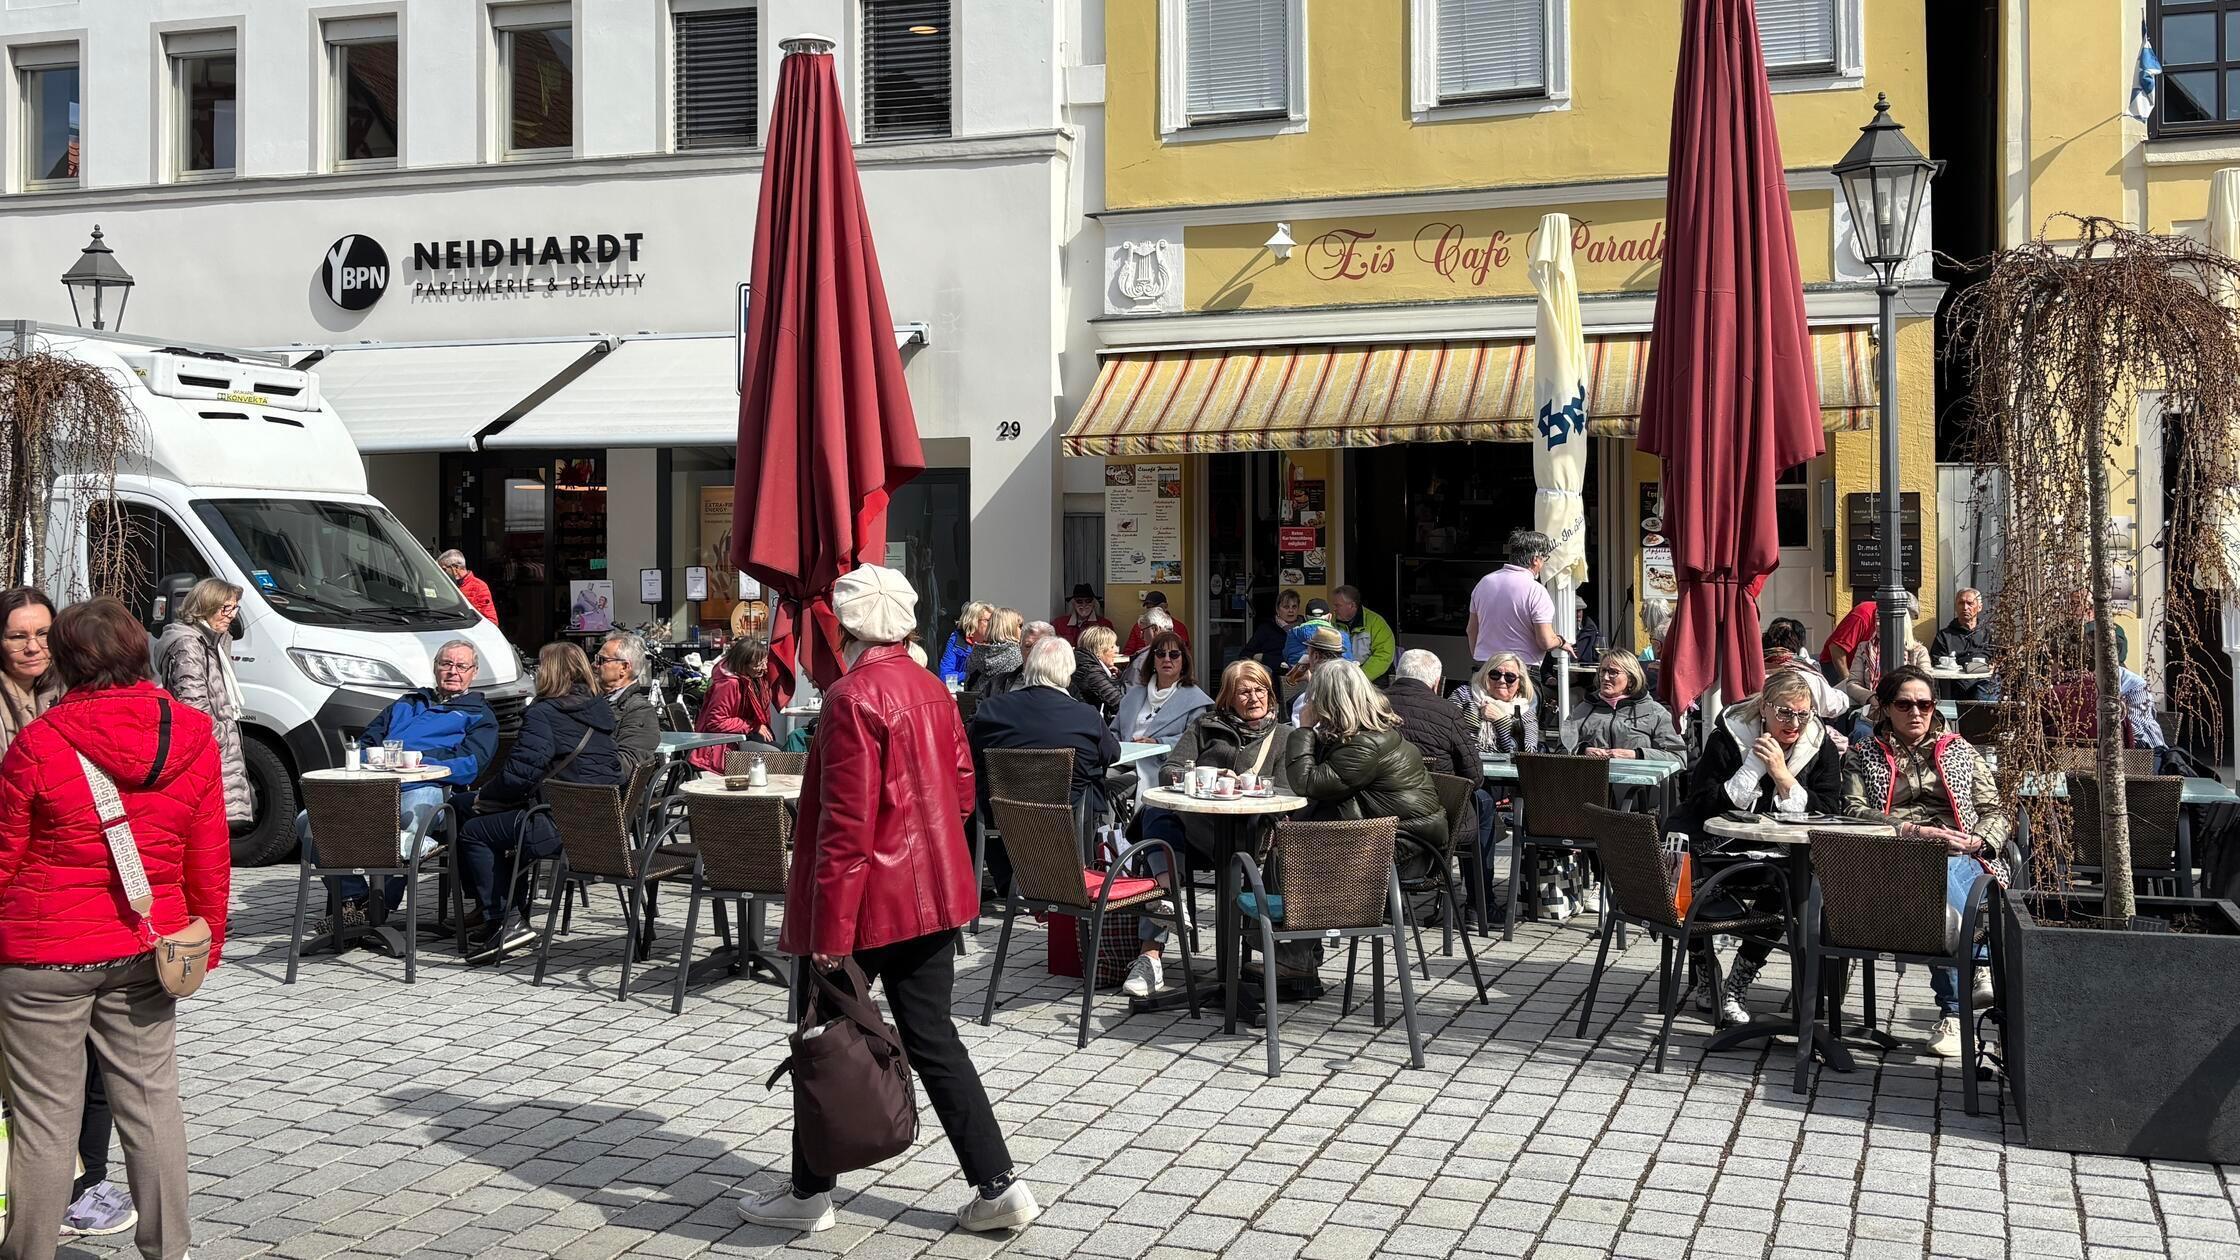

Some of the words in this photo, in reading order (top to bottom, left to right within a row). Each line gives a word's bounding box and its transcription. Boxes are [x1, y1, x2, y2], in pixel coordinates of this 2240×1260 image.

[413, 232, 644, 271] NEIDHARDT
[1305, 227, 1396, 281] Eis
[1413, 222, 1511, 286] Café
[416, 278, 535, 297] PARFÜMERIE
[547, 276, 559, 292] &
[570, 273, 647, 292] BEAUTY
[1000, 421, 1021, 438] 29
